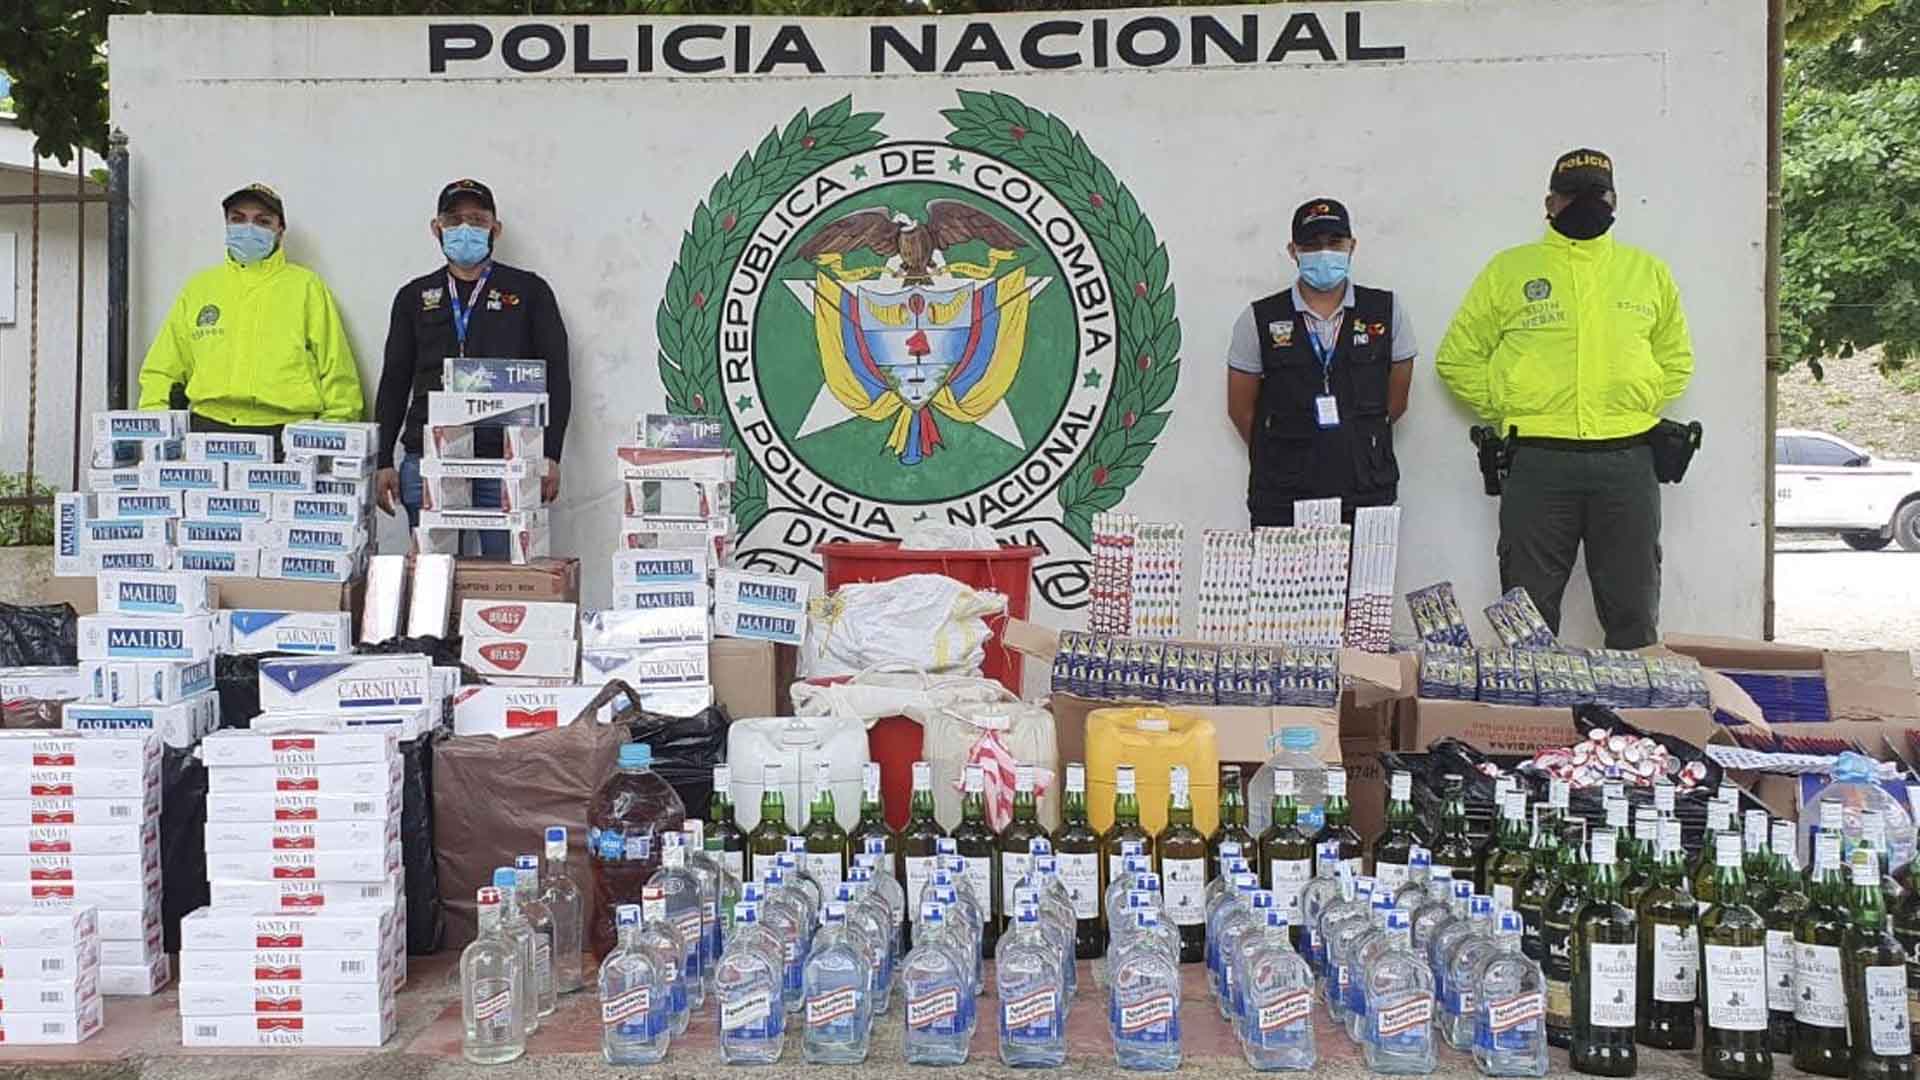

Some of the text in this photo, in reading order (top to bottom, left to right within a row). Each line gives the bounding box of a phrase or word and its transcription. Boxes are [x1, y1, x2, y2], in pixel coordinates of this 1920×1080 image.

[429, 11, 1406, 75] POLICIA NACIONAL
[1558, 154, 1610, 172] POLICIA
[726, 149, 1113, 383] REPUBLICA DE COLOMBIA
[506, 365, 544, 384] TIME
[465, 399, 505, 415] TIME
[111, 419, 161, 433] MALIBU
[691, 422, 722, 440] TIME
[206, 440, 257, 455] MALIBU
[159, 469, 213, 482] MALIBU
[248, 469, 302, 483] MALIBU
[743, 403, 1098, 534] POLICIA NACIONAL
[316, 481, 356, 496] ALIBU
[118, 496, 170, 511] MALIBU
[207, 498, 261, 513] MALIBU
[294, 501, 348, 516] MALIBU
[60, 503, 75, 556] MALIBU
[289, 530, 343, 546] MALIBU
[102, 554, 155, 568] MALIBU
[281, 558, 335, 573] MALIBU
[636, 560, 693, 576] MALIBU
[119, 583, 177, 604] MALIBU
[636, 592, 694, 608] MALIBU
[738, 582, 798, 603] MALIBU
[736, 613, 796, 634] MALIBU
[110, 629, 183, 649] MALIBU
[276, 629, 336, 648] CARNIVAL
[639, 662, 705, 679] CARNIVAL
[337, 680, 423, 702] CARNIVAL
[505, 693, 558, 706] SANTA FE
[256, 921, 286, 932] SANTA
[255, 953, 285, 964] SANTA
[255, 985, 285, 996] SANTA
